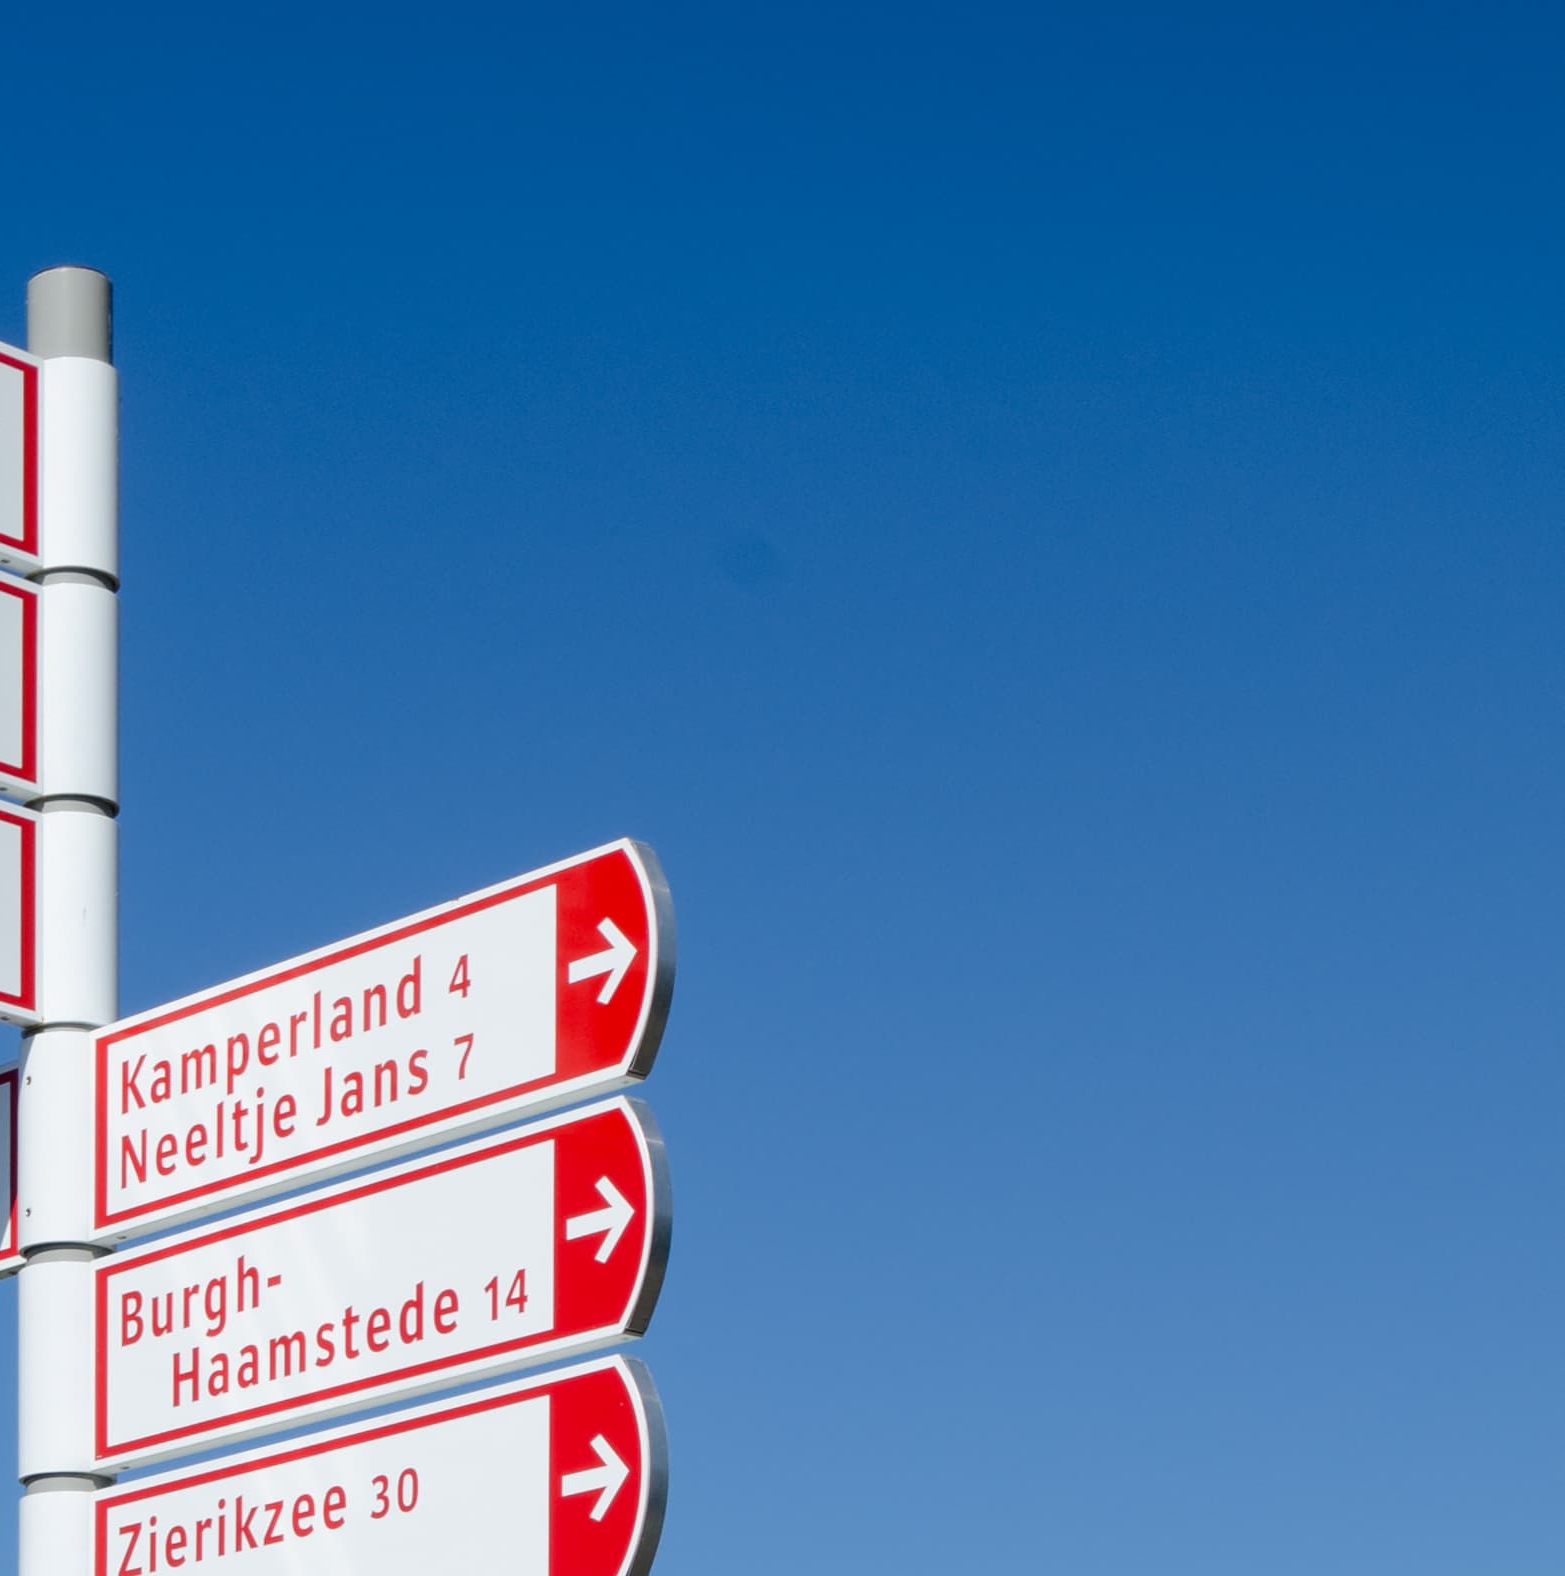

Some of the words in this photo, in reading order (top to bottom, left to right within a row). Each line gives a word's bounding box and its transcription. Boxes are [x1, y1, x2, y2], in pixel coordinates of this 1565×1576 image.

[121, 955, 421, 1115] Kamperland
[448, 954, 471, 998] 4
[121, 1087, 297, 1189] Neeltje
[316, 1049, 429, 1127] Jans
[454, 1033, 474, 1080] 7
[121, 1256, 282, 1347] Burgh-
[172, 1282, 459, 1408] Haamstede
[484, 1268, 528, 1321] 14
[370, 1467, 419, 1520] 30
